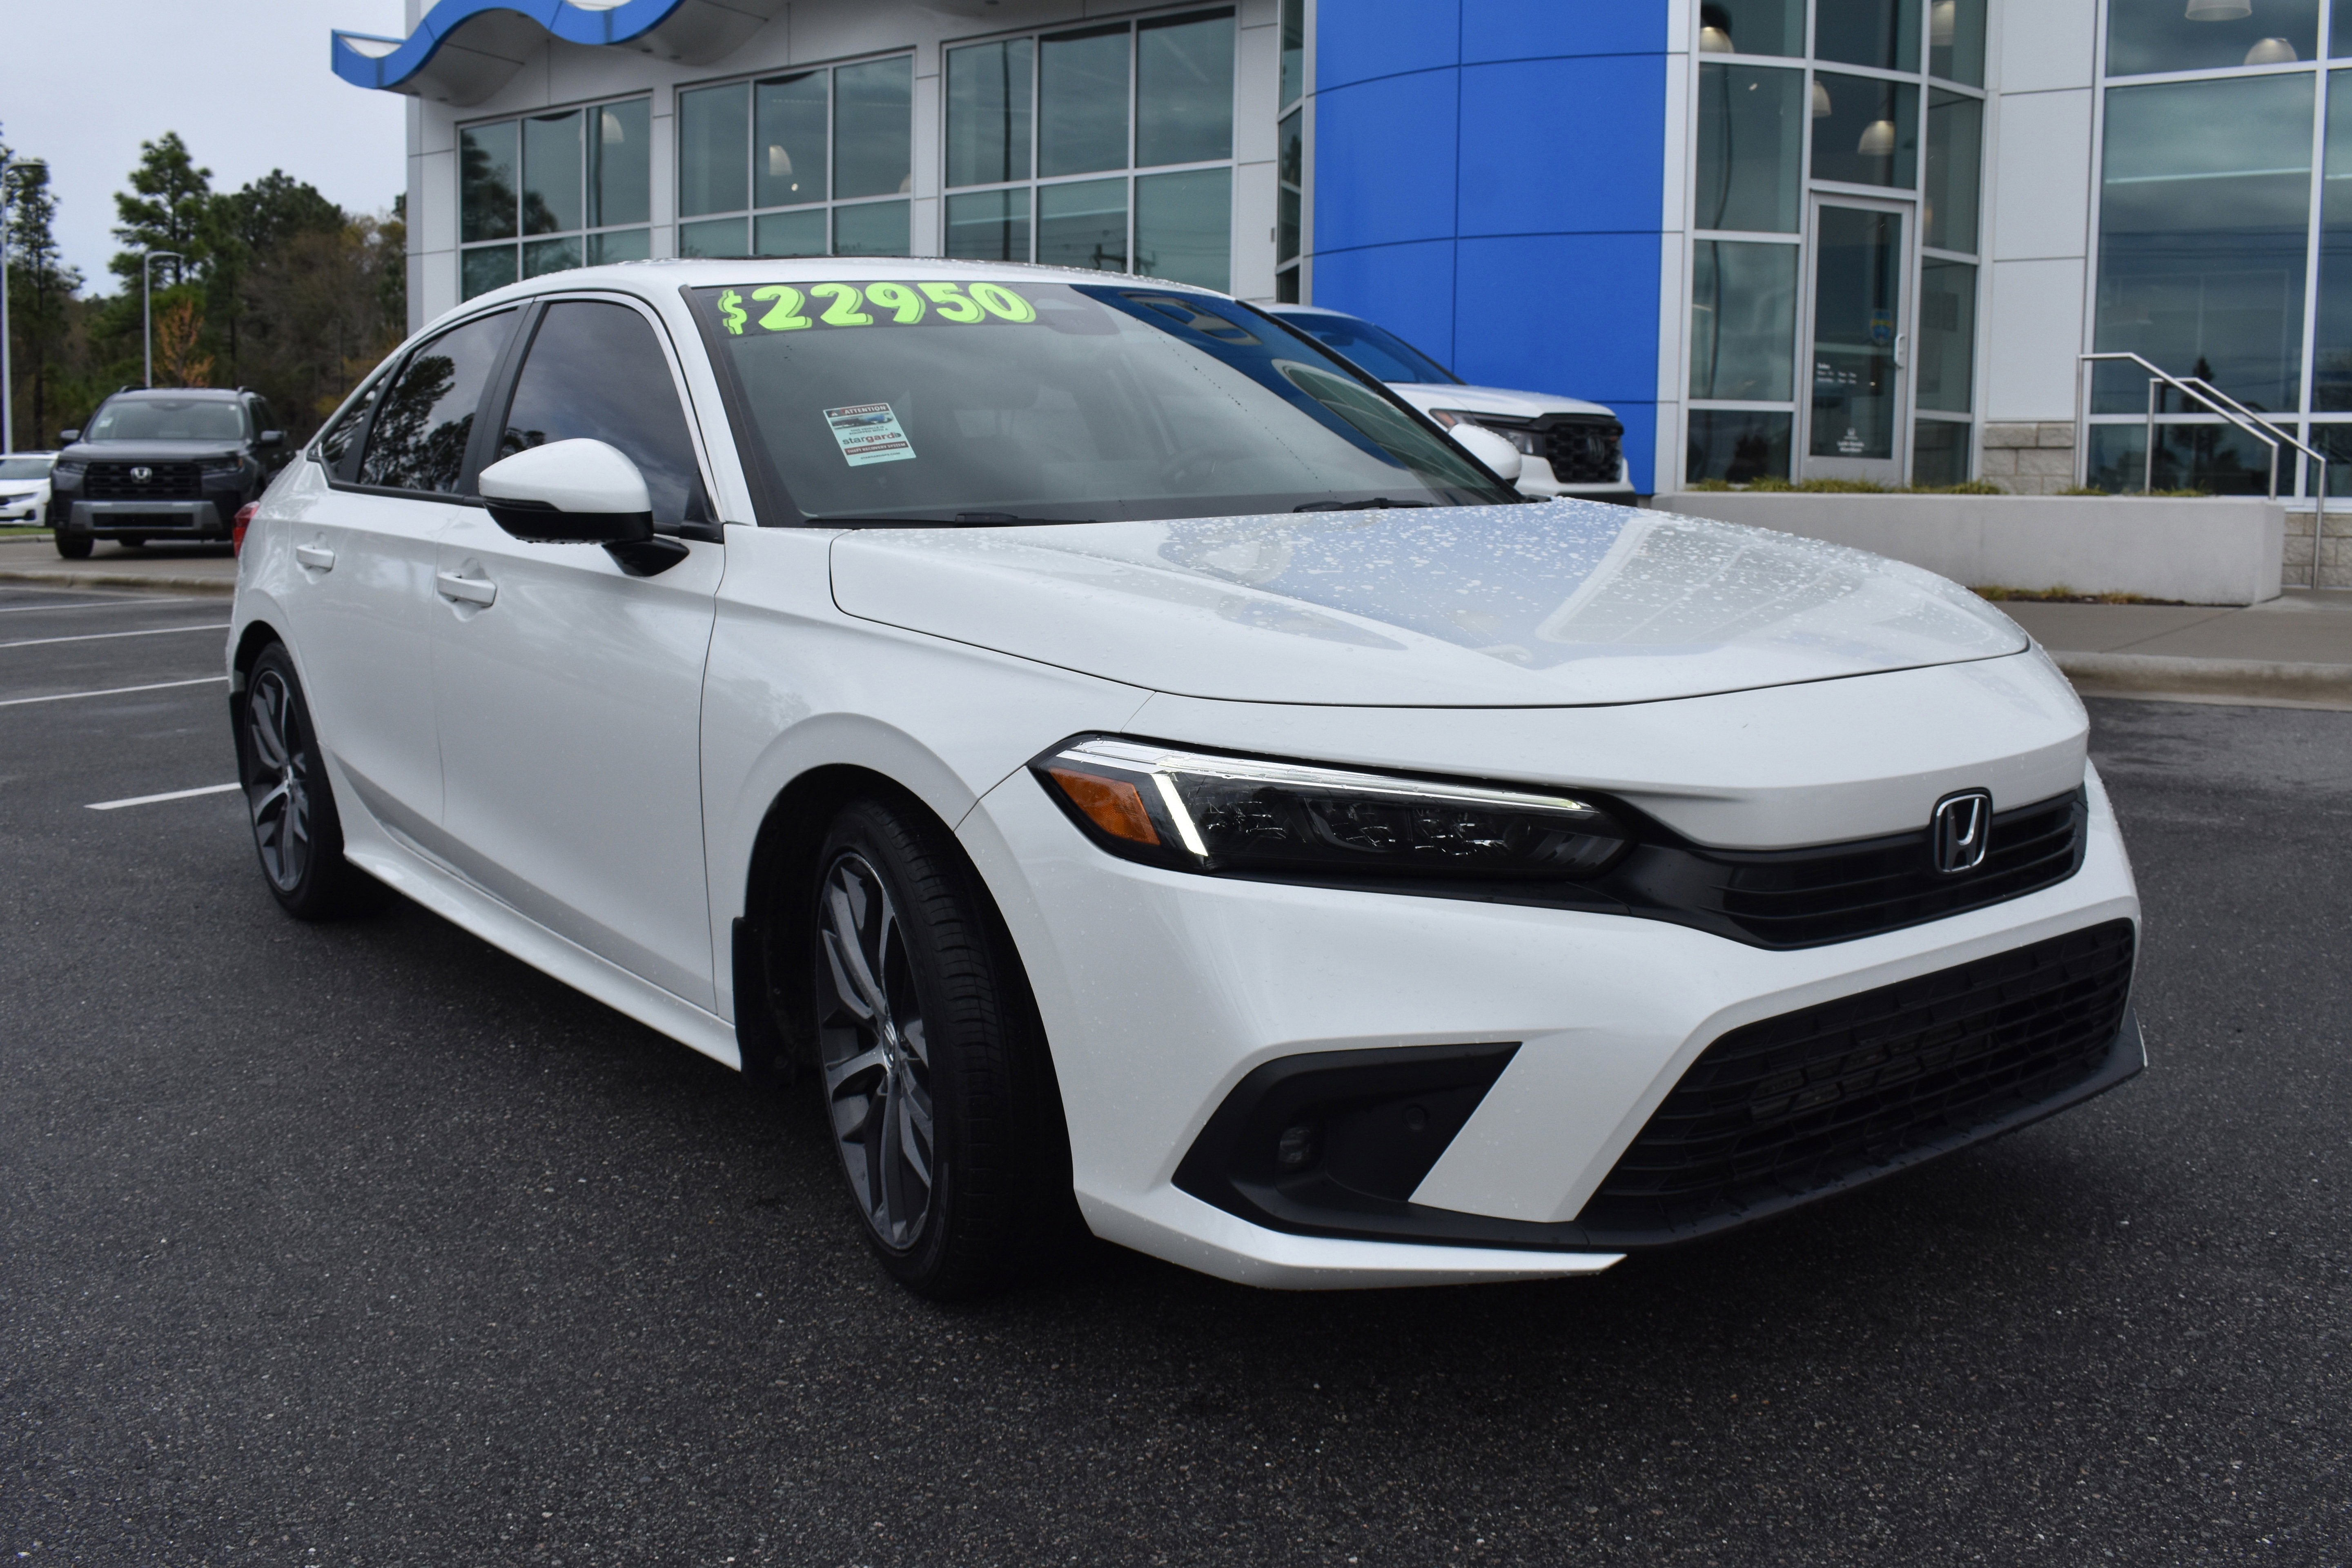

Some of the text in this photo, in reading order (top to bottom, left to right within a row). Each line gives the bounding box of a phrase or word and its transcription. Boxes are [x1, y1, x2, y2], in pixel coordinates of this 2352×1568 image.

[718, 282, 1036, 335] $22950
[845, 405, 886, 414] ATTENTION
[842, 432, 895, 445] stargard
